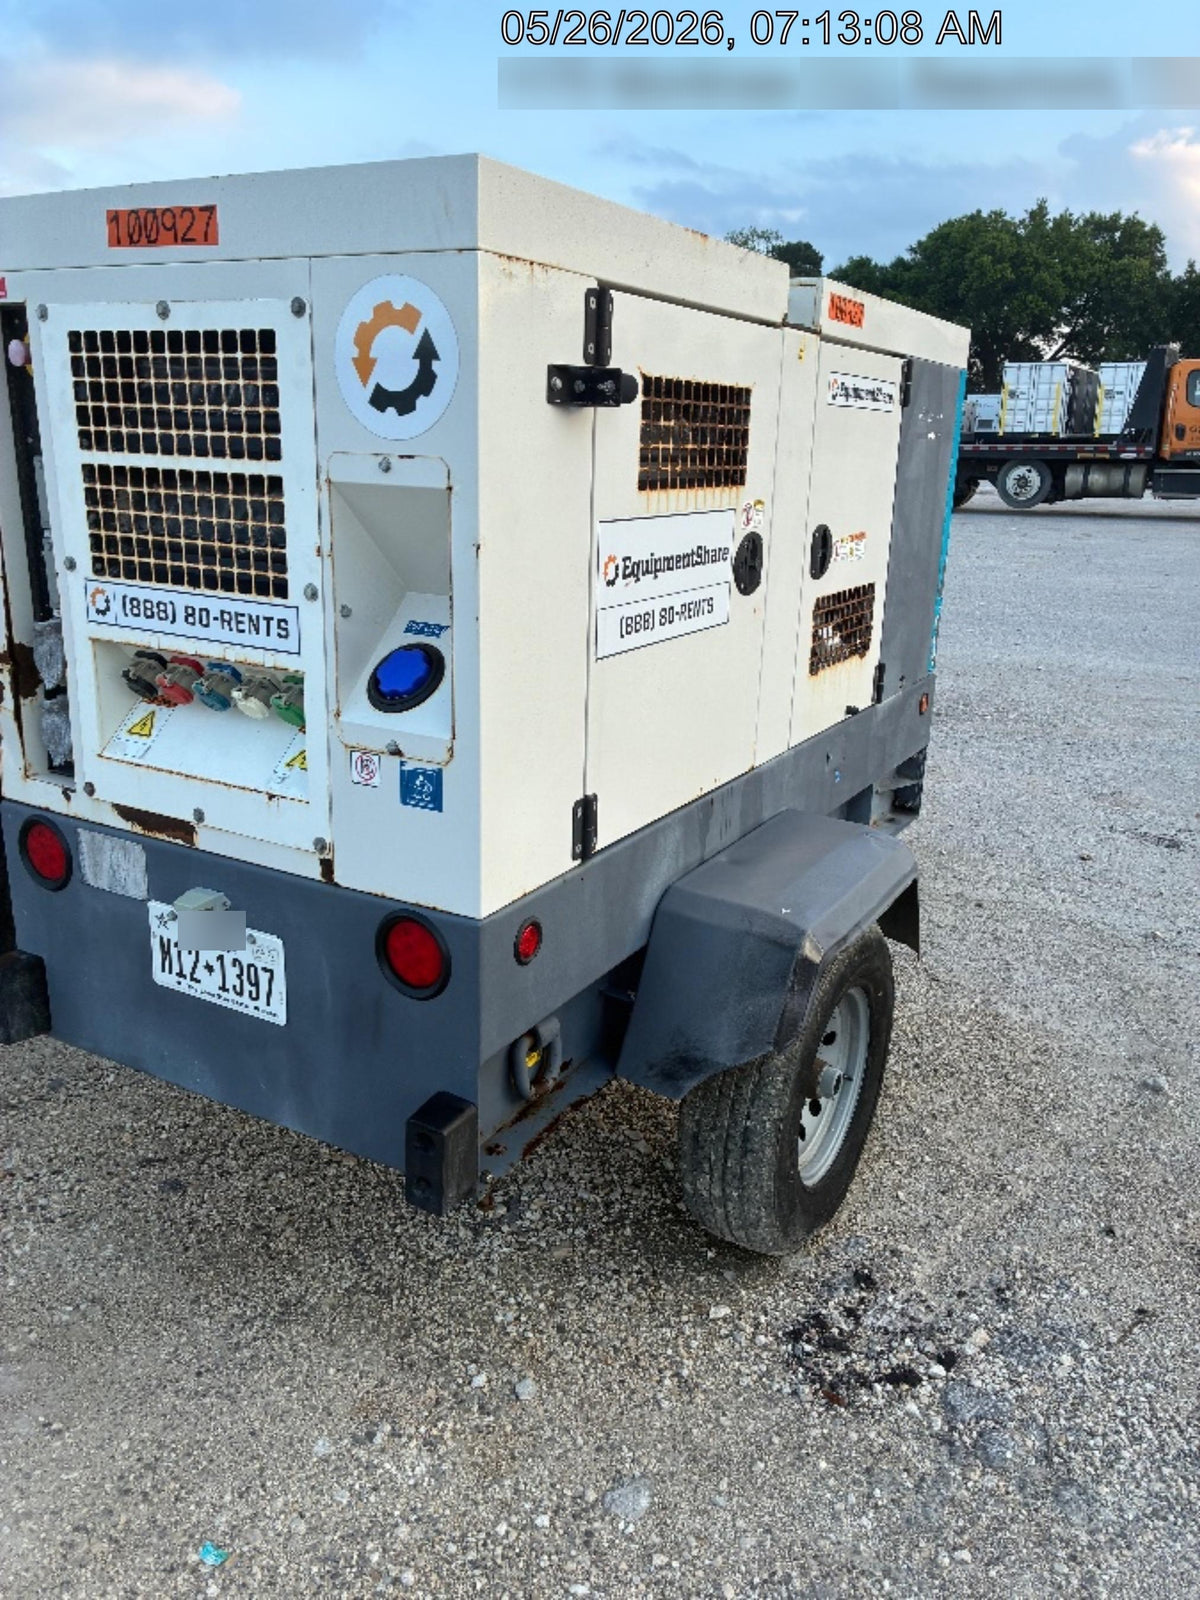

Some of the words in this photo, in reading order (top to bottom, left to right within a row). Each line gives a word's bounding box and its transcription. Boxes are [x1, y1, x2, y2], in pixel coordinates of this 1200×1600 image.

[109, 204, 216, 246] 100927
[621, 545, 730, 584] EquipmentShare
[121, 594, 177, 625] (888)
[184, 605, 290, 640] 80-RENTS
[619, 609, 655, 639] (888)
[659, 597, 714, 627] 80-RENTS
[216, 953, 274, 1007] 1397
